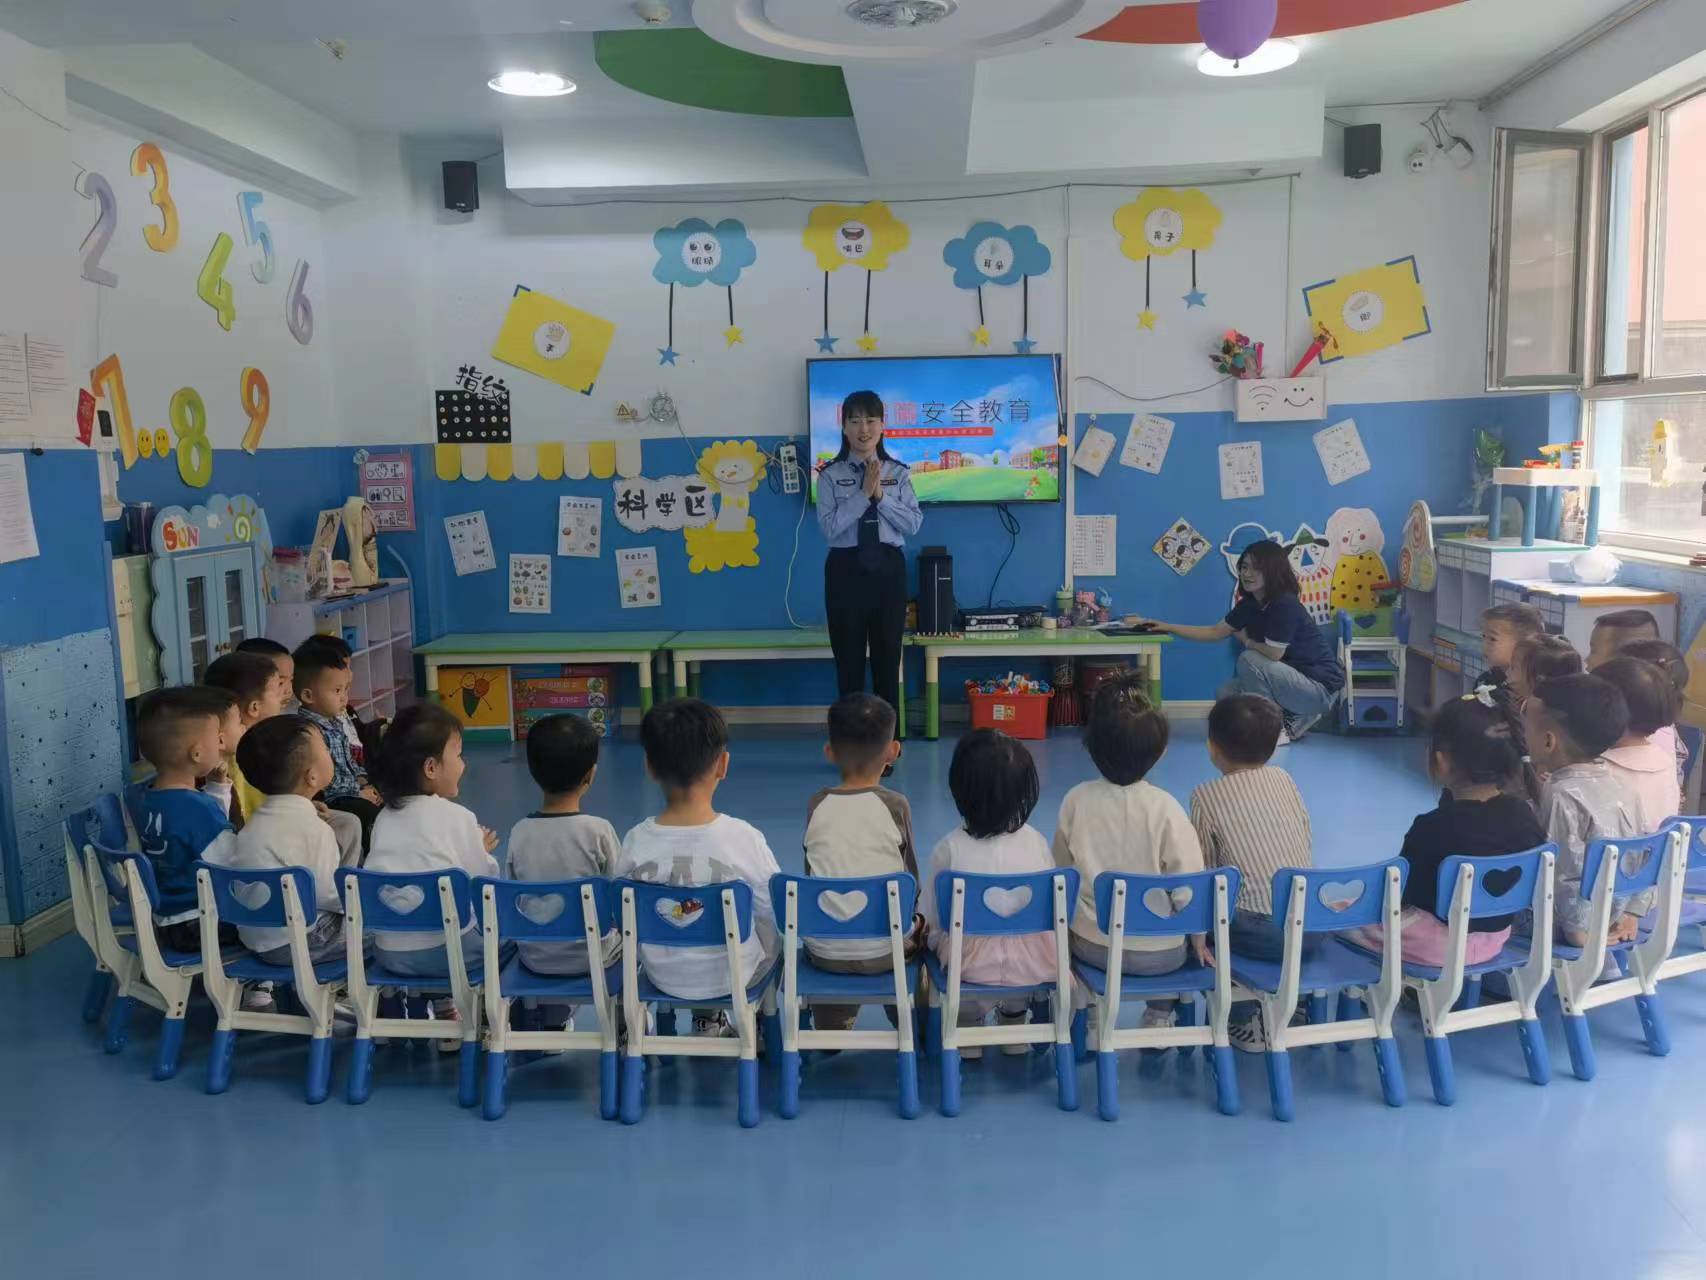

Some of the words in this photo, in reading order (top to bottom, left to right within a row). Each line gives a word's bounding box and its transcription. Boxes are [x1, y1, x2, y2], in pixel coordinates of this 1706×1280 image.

[76, 168, 118, 288] 2
[130, 142, 180, 252] 3
[237, 191, 276, 284] 5
[197, 231, 236, 331] 4
[286, 259, 314, 345] 6
[90, 353, 138, 470] 7
[169, 387, 213, 488] 8
[240, 367, 270, 455] 9
[162, 520, 200, 551] SUN
[617, 485, 707, 520] 科学区
